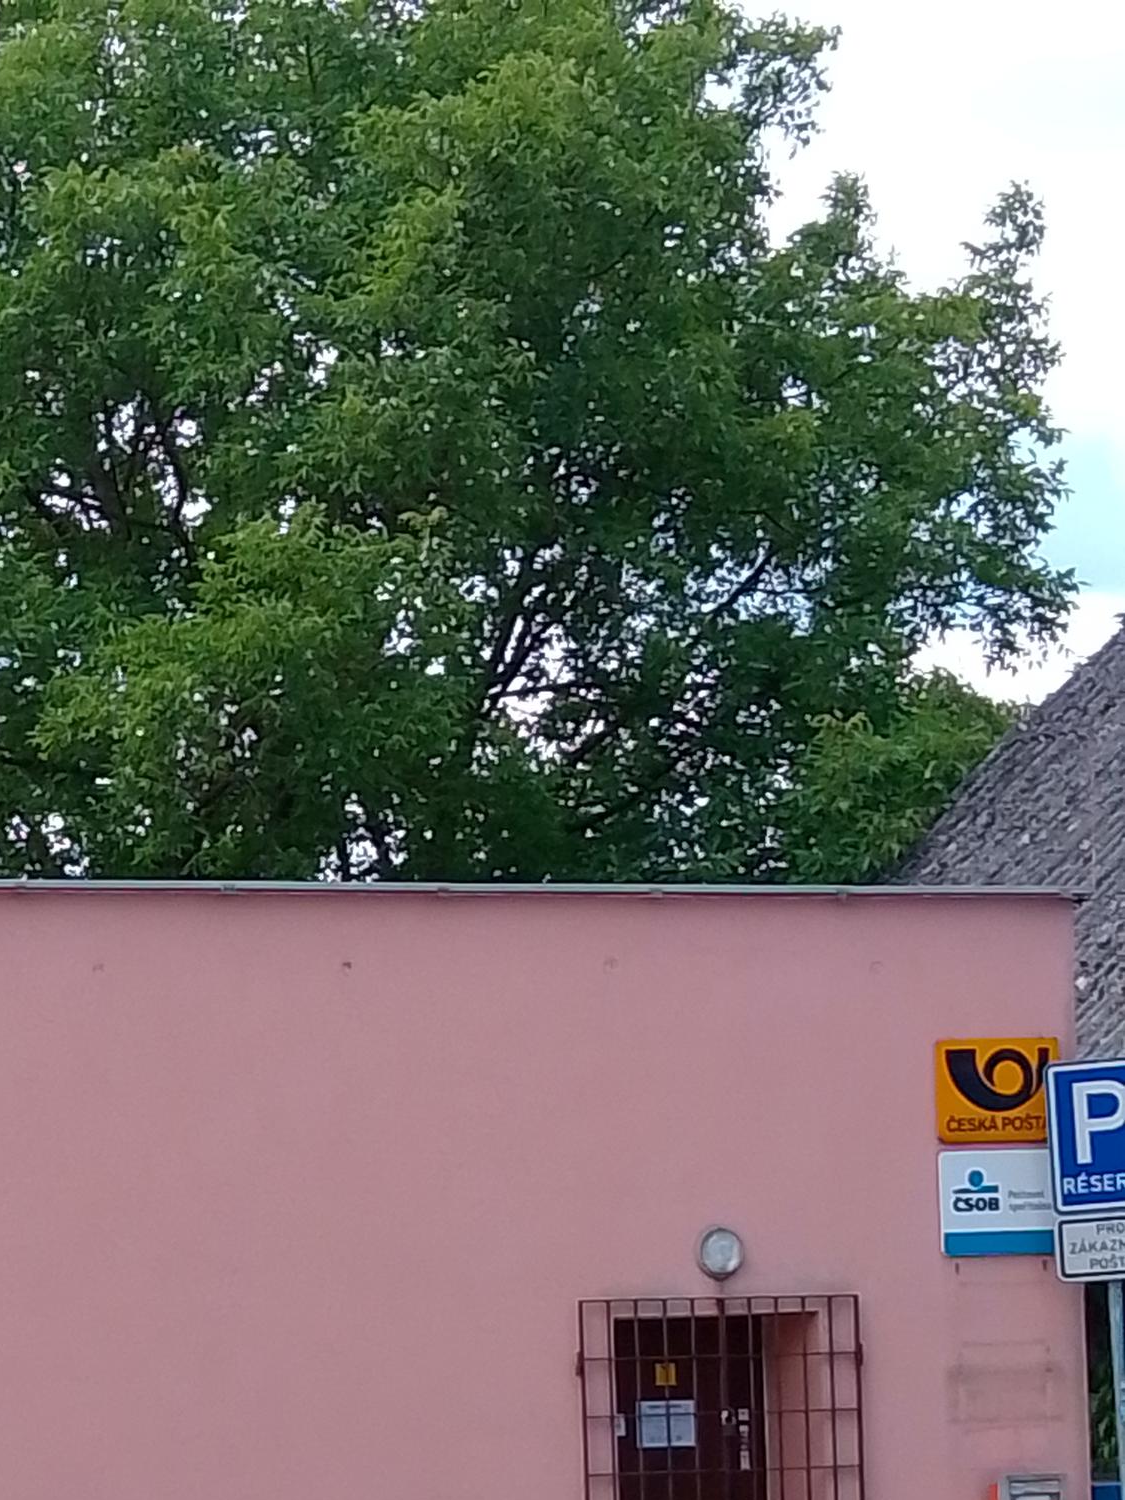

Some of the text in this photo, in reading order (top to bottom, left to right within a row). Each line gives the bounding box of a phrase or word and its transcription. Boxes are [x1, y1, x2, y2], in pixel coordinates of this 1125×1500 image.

[946, 1115, 998, 1132] ČESKÁ
[1072, 1080, 1125, 1165] P
[953, 1197, 1000, 1212] ČSOB
[1096, 1222, 1125, 1236] PRO
